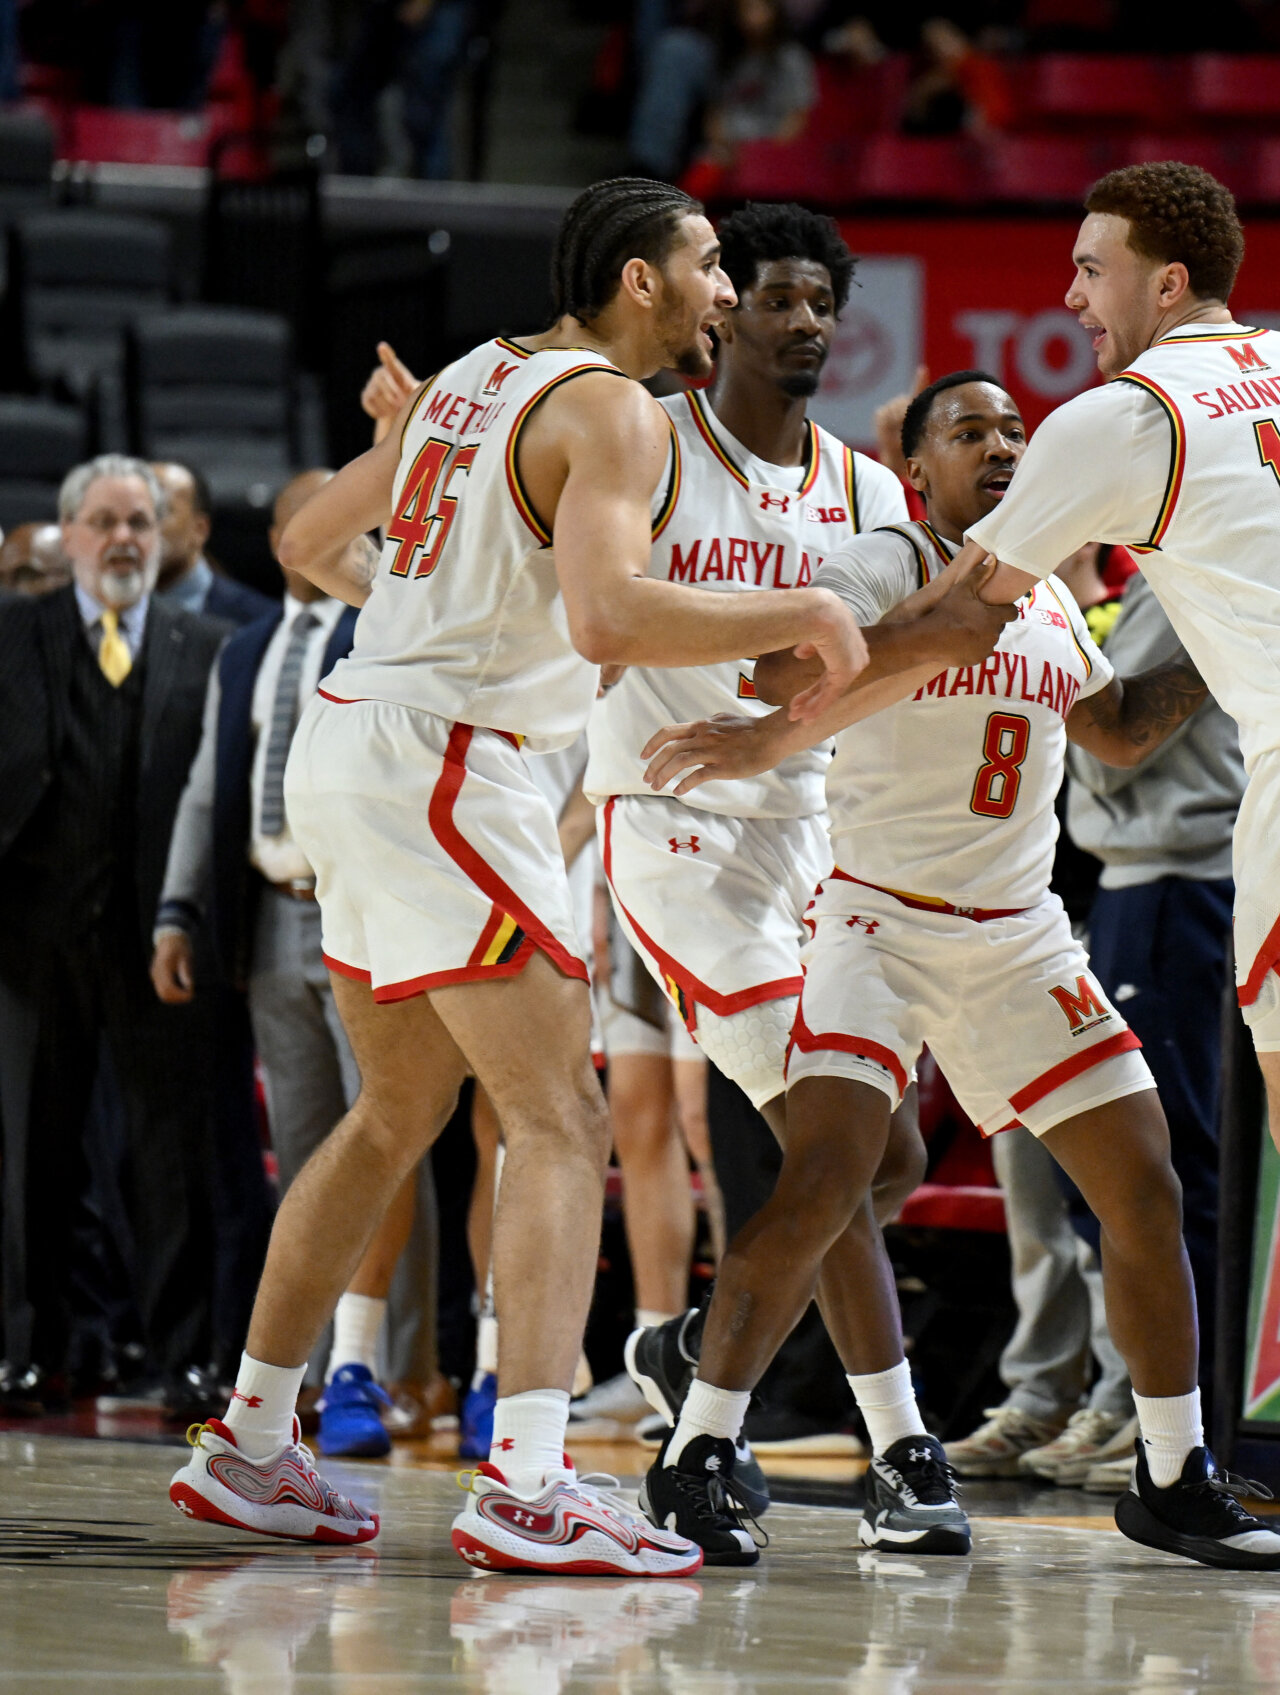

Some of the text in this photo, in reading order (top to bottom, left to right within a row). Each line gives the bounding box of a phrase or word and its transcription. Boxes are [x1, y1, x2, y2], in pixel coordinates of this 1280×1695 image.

[485, 361, 520, 391] M
[1222, 343, 1269, 371] M
[386, 437, 480, 579] 45
[668, 538, 824, 589] MARYLA
[970, 711, 1030, 819] 8
[1047, 975, 1108, 1031] M
